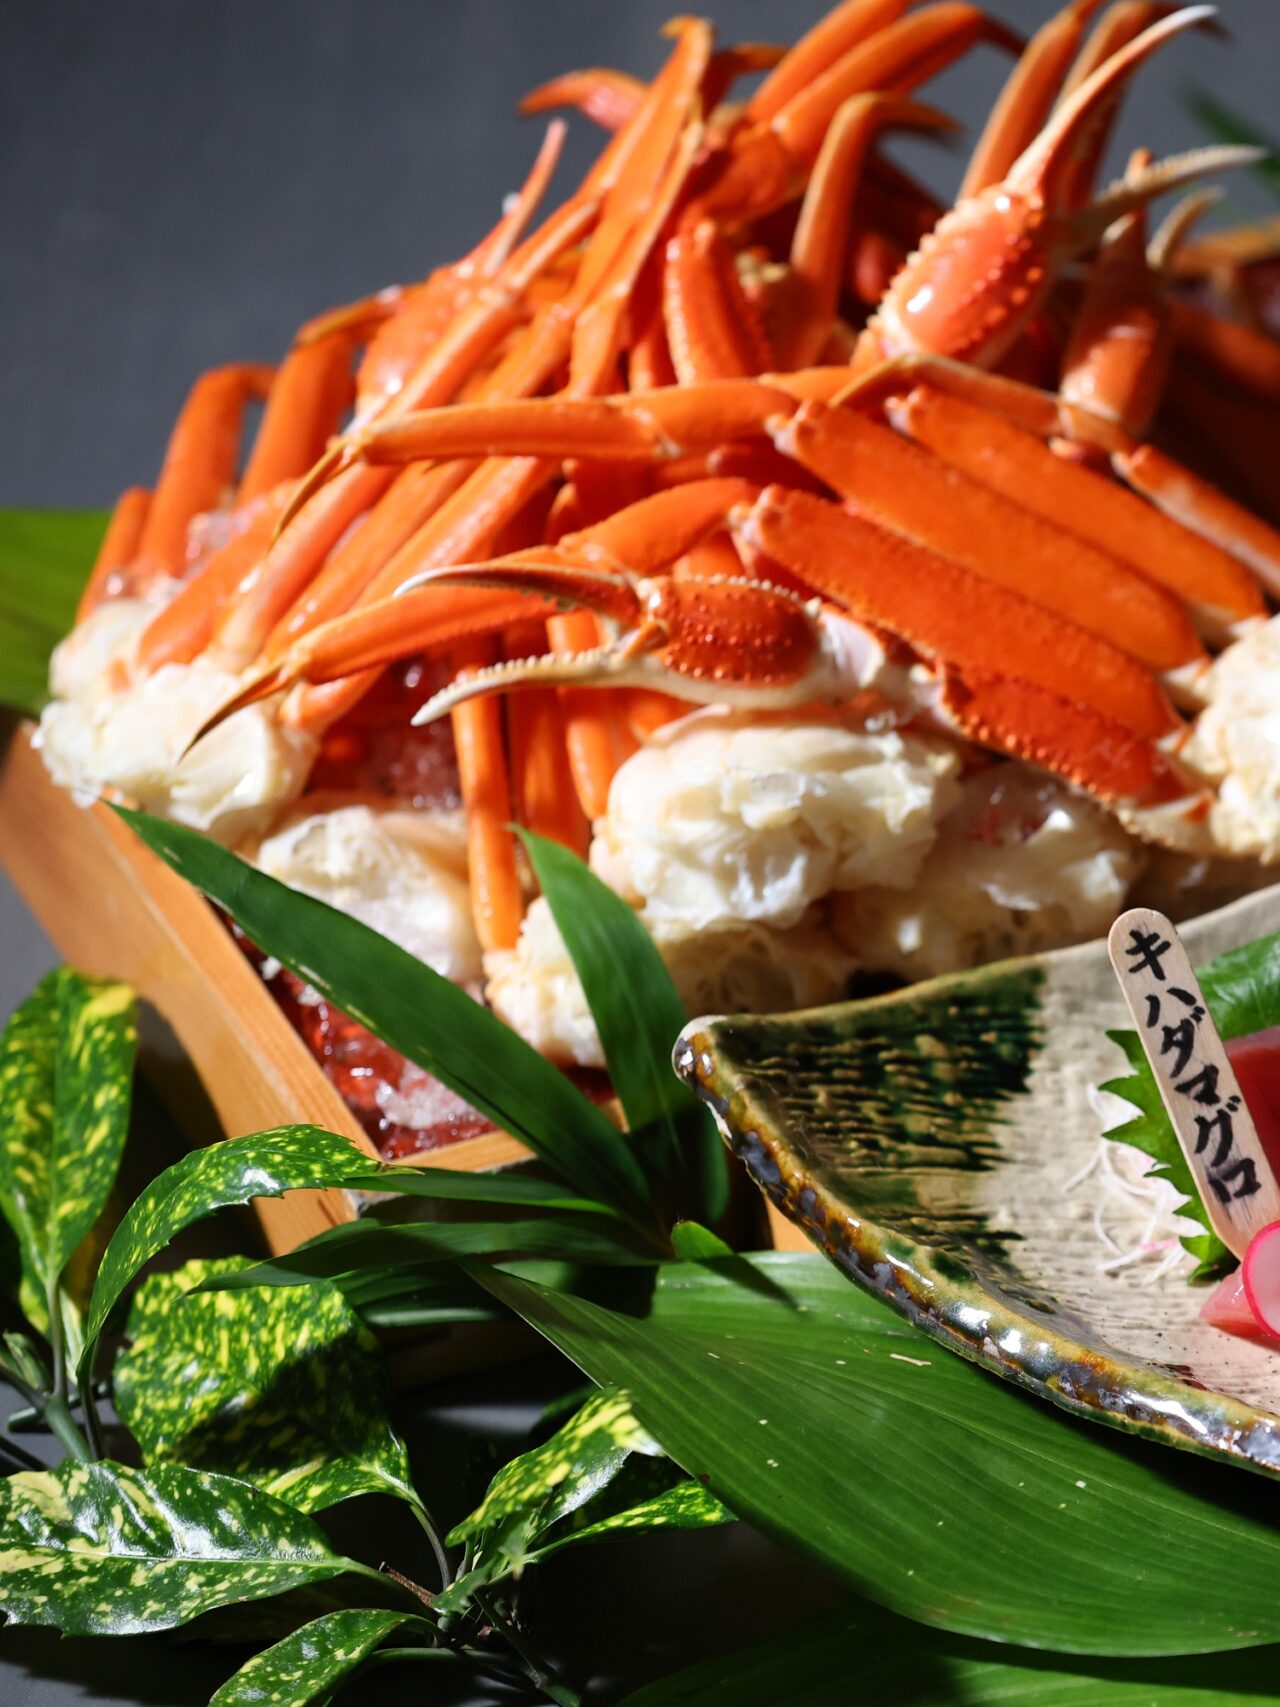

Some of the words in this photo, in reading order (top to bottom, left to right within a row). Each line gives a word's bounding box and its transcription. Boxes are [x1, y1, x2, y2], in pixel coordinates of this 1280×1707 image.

[1126, 929, 1262, 1205] キハダマグロ
